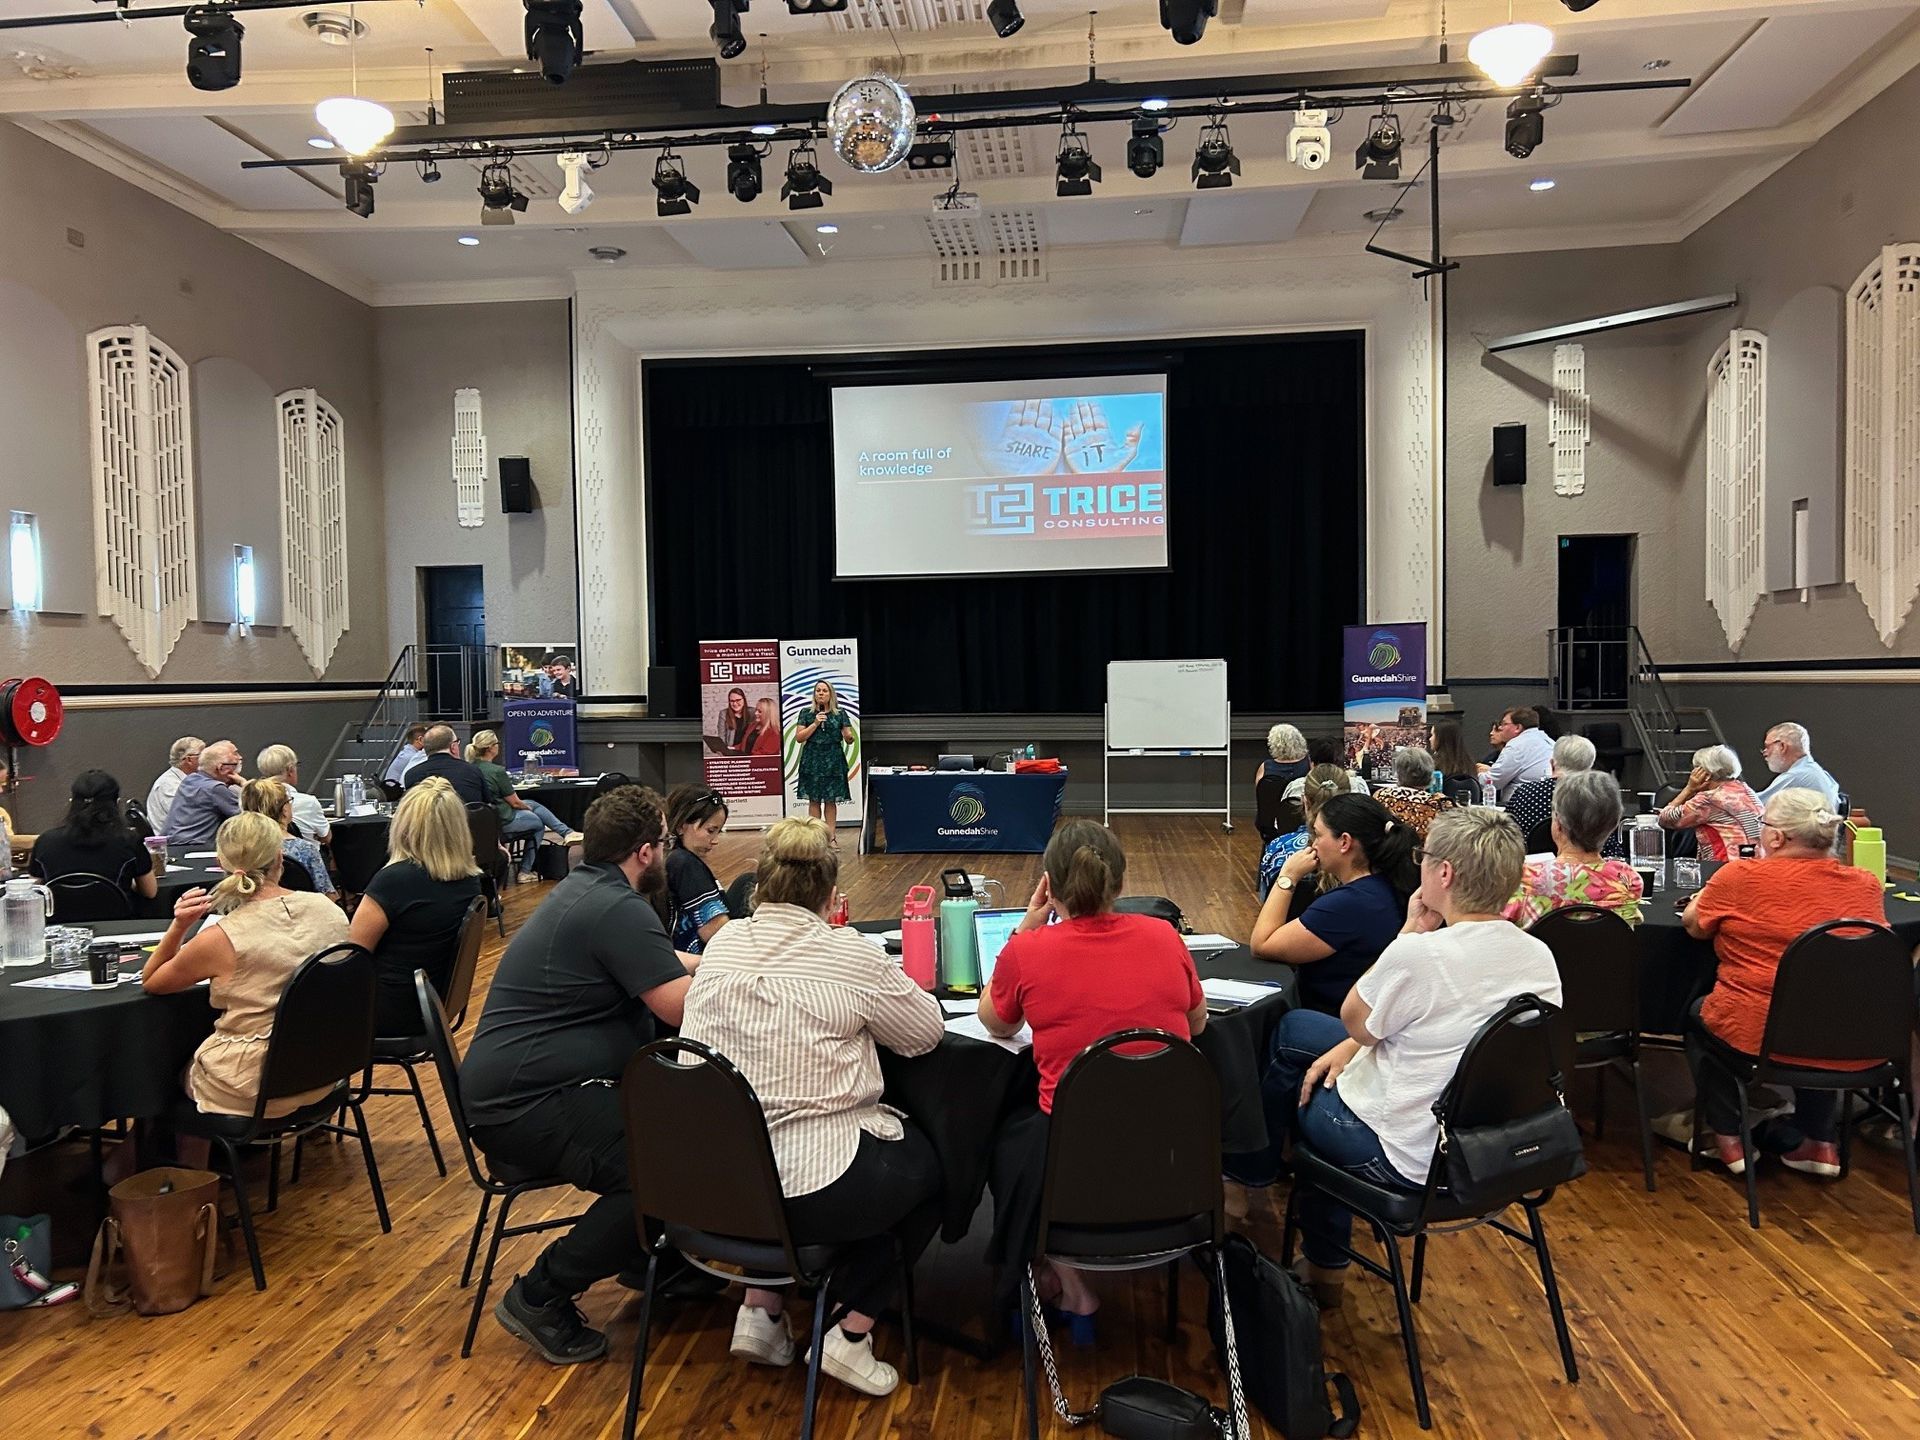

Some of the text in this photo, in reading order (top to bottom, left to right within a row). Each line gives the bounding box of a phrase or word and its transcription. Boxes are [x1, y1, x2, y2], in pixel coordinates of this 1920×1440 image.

[859, 447, 952, 461] A room full of
[1005, 441, 1052, 459] SHARE
[860, 463, 933, 476] knowledge
[1042, 484, 1164, 516] TRICE
[1044, 516, 1164, 529] CONSULTING
[787, 645, 851, 656] Gunnedah
[734, 663, 770, 675] TRICE
